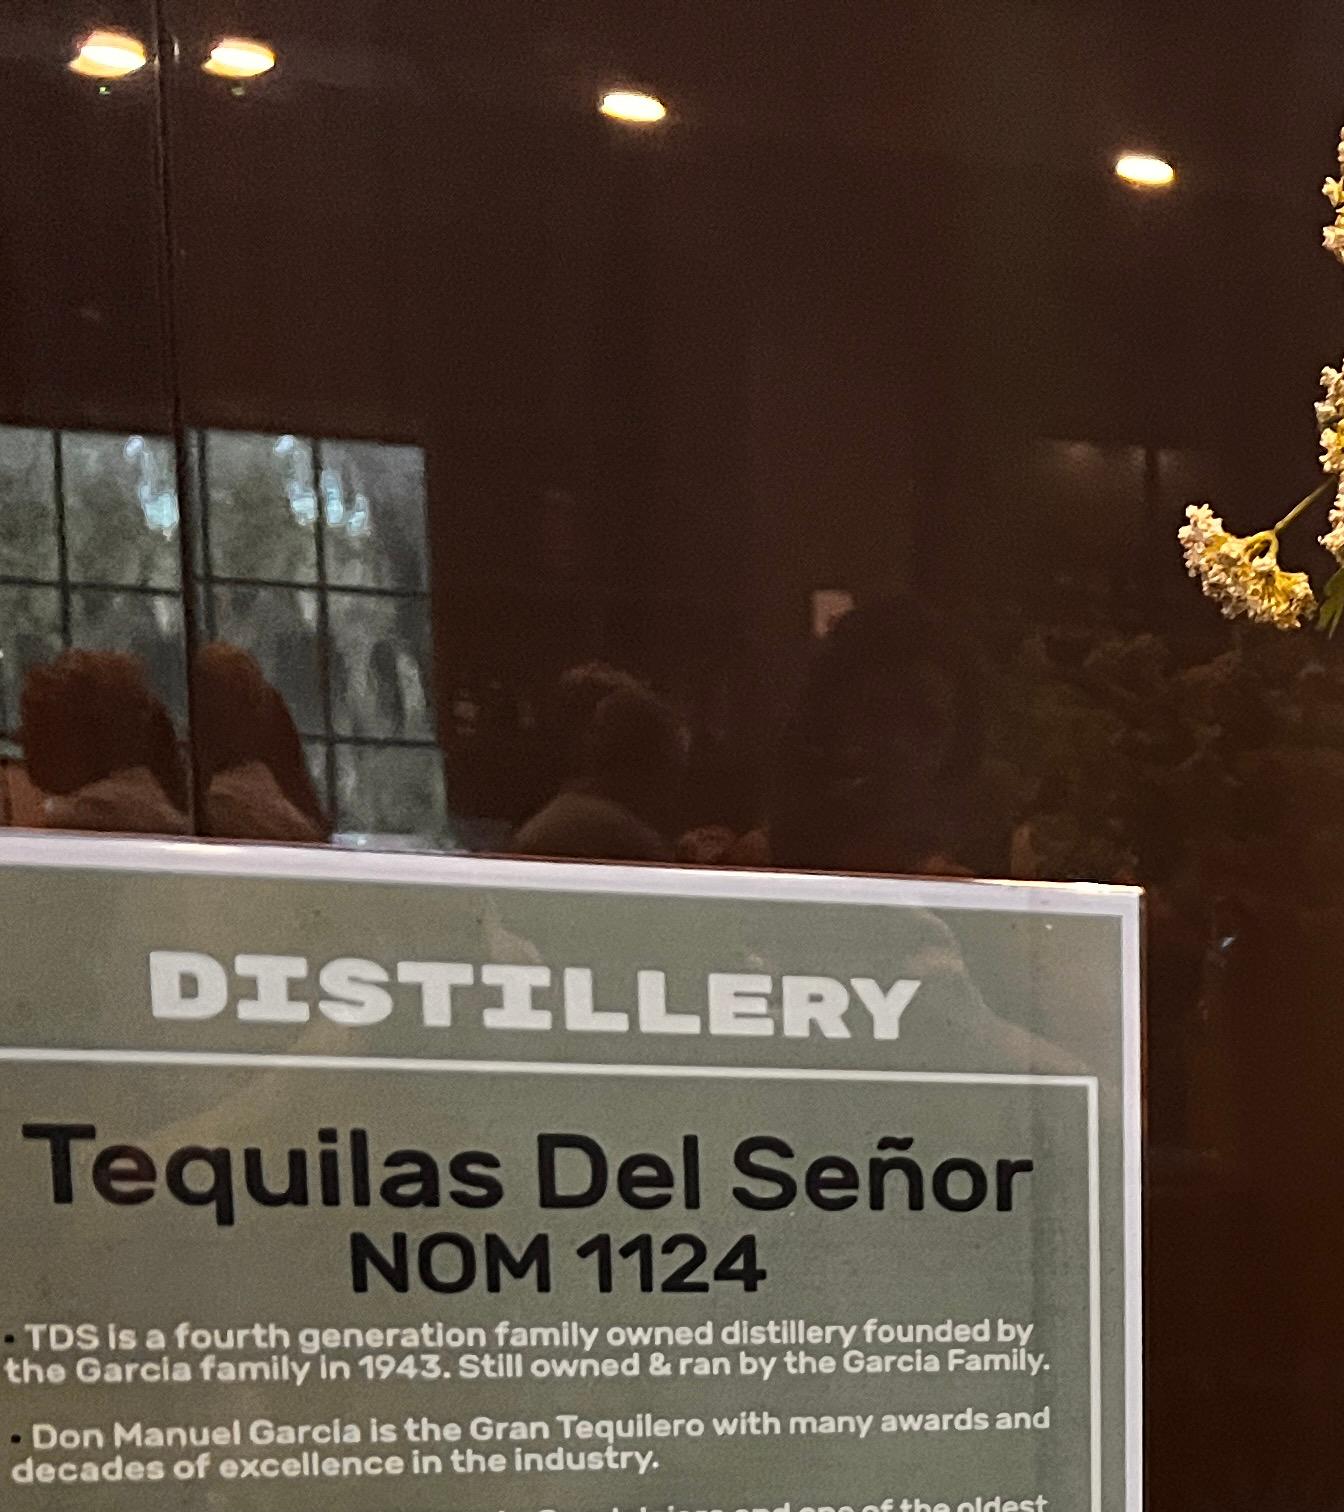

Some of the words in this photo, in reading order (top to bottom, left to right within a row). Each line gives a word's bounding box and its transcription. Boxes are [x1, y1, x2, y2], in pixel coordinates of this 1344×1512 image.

[149, 951, 921, 1040] DISTILLERY
[22, 1123, 504, 1226] Tequilas
[537, 1132, 702, 1210] Del
[731, 1136, 1034, 1212] Señor
[351, 1231, 551, 1293] NOM
[576, 1233, 767, 1293] 1124
[25, 1324, 99, 1350] TDS
[109, 1324, 136, 1349] is
[146, 1329, 165, 1349] a
[175, 1323, 290, 1349] fourth
[299, 1322, 486, 1353] generation
[495, 1321, 599, 1351] family
[607, 1321, 713, 1346] owned
[721, 1320, 856, 1348] distillery
[864, 1319, 990, 1343] founded
[998, 1319, 1033, 1346] by
[4, 1358, 65, 1383] the
[76, 1357, 191, 1382] Garcia
[200, 1355, 310, 1386] family
[321, 1355, 350, 1379] in
[359, 1355, 450, 1379] 1943.
[459, 1354, 522, 1378] Still
[531, 1353, 639, 1377] owned
[649, 1353, 672, 1375] &
[680, 1358, 730, 1375] ran
[740, 1351, 776, 1380] by
[784, 1351, 836, 1374] the
[843, 1349, 940, 1373] Garcia
[948, 1348, 1049, 1375] Family.
[33, 1424, 103, 1449] Don
[114, 1420, 240, 1448] Manuel
[250, 1419, 360, 1444] Garcia
[371, 1418, 397, 1442] is
[404, 1417, 461, 1441] the
[470, 1417, 549, 1440] Gran
[556, 1414, 704, 1444] Tequilero
[713, 1412, 780, 1435] with
[790, 1415, 873, 1438] many
[881, 1408, 989, 1432] awards
[996, 1406, 1049, 1429] and
[12, 1456, 164, 1483] decades
[174, 1452, 210, 1479] of
[220, 1451, 404, 1478] excellence
[413, 1450, 442, 1474] in
[451, 1449, 506, 1472] the
[515, 1446, 659, 1474] industry.
